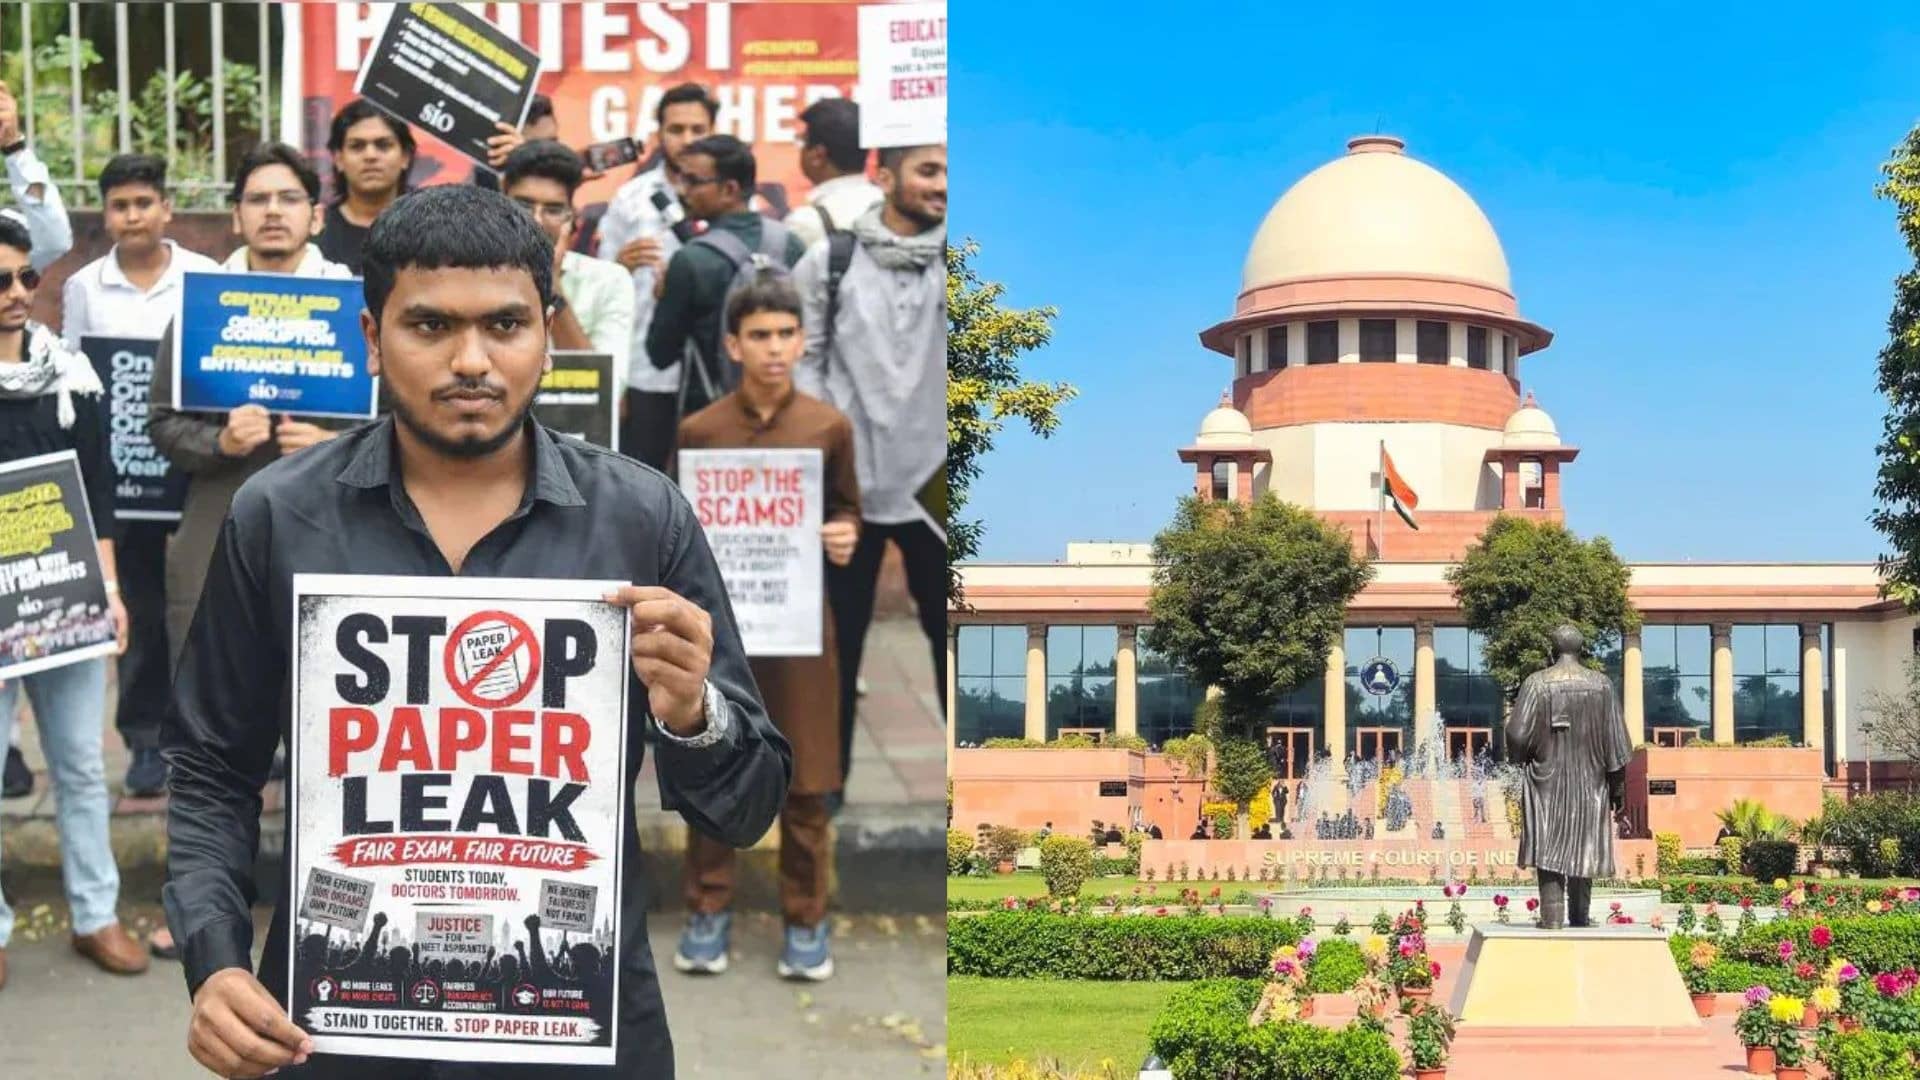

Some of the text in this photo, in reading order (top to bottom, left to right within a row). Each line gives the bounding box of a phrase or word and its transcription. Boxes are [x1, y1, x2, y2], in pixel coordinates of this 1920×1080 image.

[419, 100, 455, 133] sio
[200, 356, 354, 379] ENTRANCE TESTS
[249, 378, 279, 400] sio
[116, 478, 143, 498] sio
[696, 468, 804, 493] STOP THE
[697, 497, 805, 527] SCAMS!
[17, 596, 43, 617] sio
[467, 633, 505, 648] PAPER
[335, 610, 598, 709] STOP
[472, 646, 503, 660] LEAK
[328, 706, 591, 783] PAPER
[342, 773, 588, 844] LEAK
[352, 839, 576, 866] FAIR EXAM, FAIR FUTURE
[1263, 850, 1363, 867] SUPREME
[1370, 850, 1442, 866] COURT
[1449, 850, 1478, 865] OF
[314, 873, 367, 896] OUR EFFORTS
[405, 868, 508, 886] STUDENTS TODAY,
[391, 884, 520, 902] DOCTORS TOMORROW.
[328, 902, 360, 920] FUTURE
[427, 917, 482, 932] JUSTICE
[445, 933, 462, 942] FOR
[421, 942, 487, 954] NEET ASPIRANTS
[352, 981, 370, 991] MORE
[371, 982, 393, 992] LEAKS
[442, 1001, 497, 1012] ACCOUNTABILITY
[324, 1012, 582, 1038] STAND TOGETHER. STOP PAPER LEAK.
